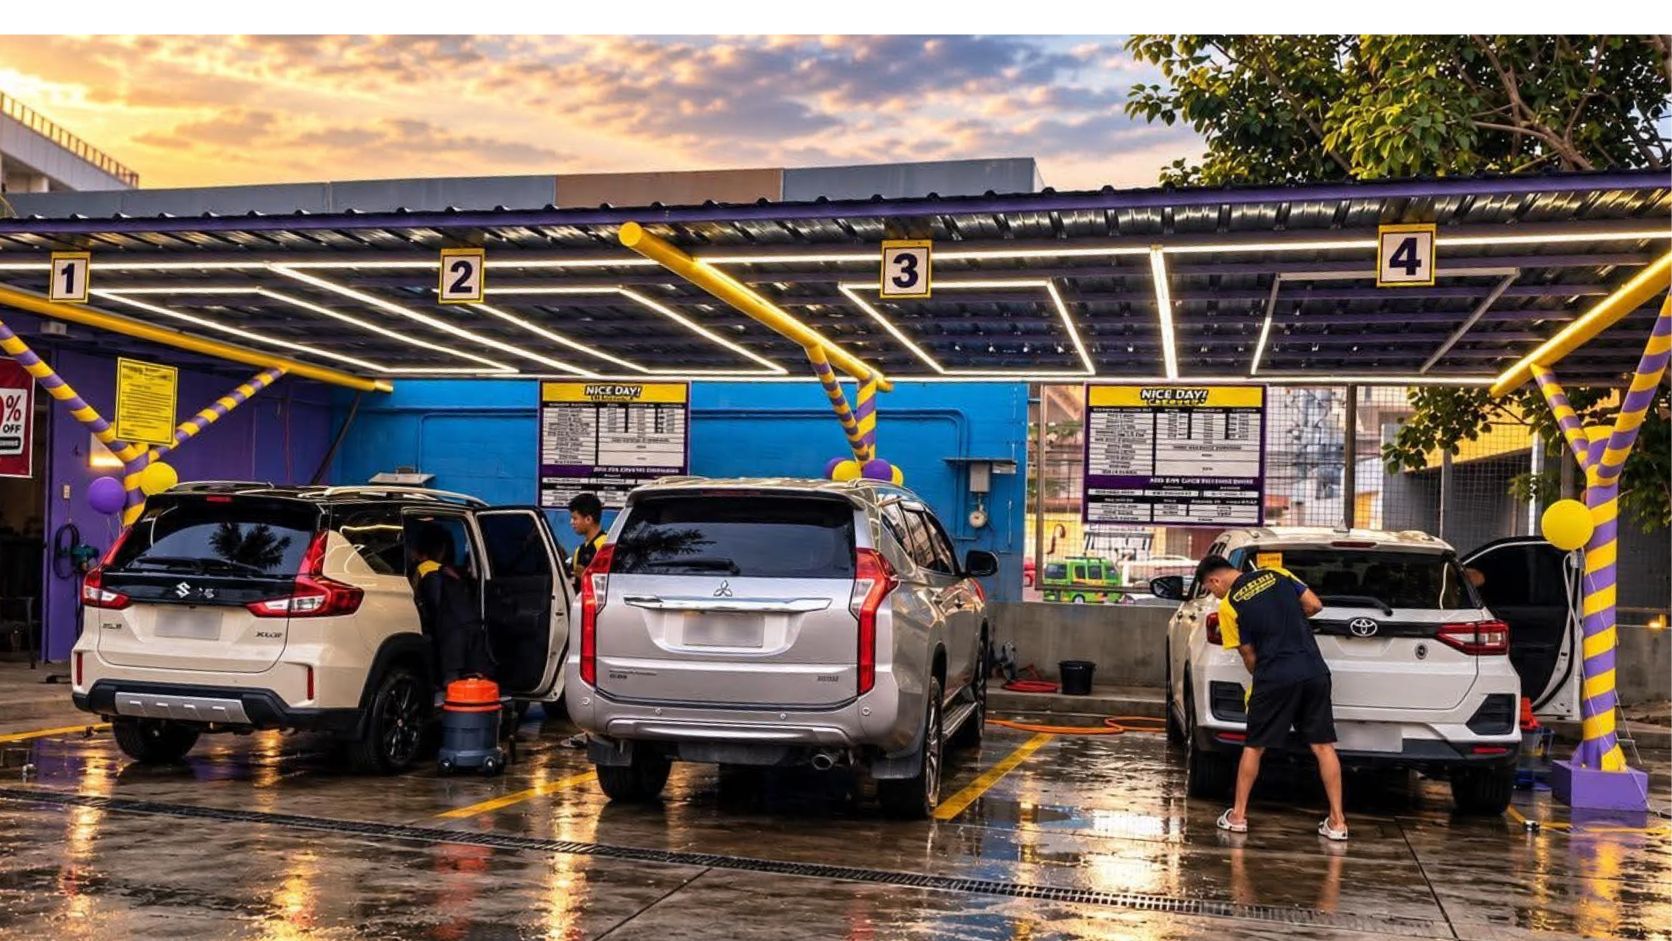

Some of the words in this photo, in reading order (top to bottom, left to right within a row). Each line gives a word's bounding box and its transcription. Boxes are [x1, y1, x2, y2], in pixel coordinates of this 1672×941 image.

[892, 253, 919, 289] 3
[1389, 237, 1422, 276] 4
[61, 262, 75, 294] 1
[449, 260, 473, 294] 2
[585, 385, 613, 396] NICE
[614, 385, 641, 398] DAY!
[1141, 388, 1172, 400] NICE
[1175, 389, 1208, 403] DAY!
[3, 424, 21, 434] OFF
